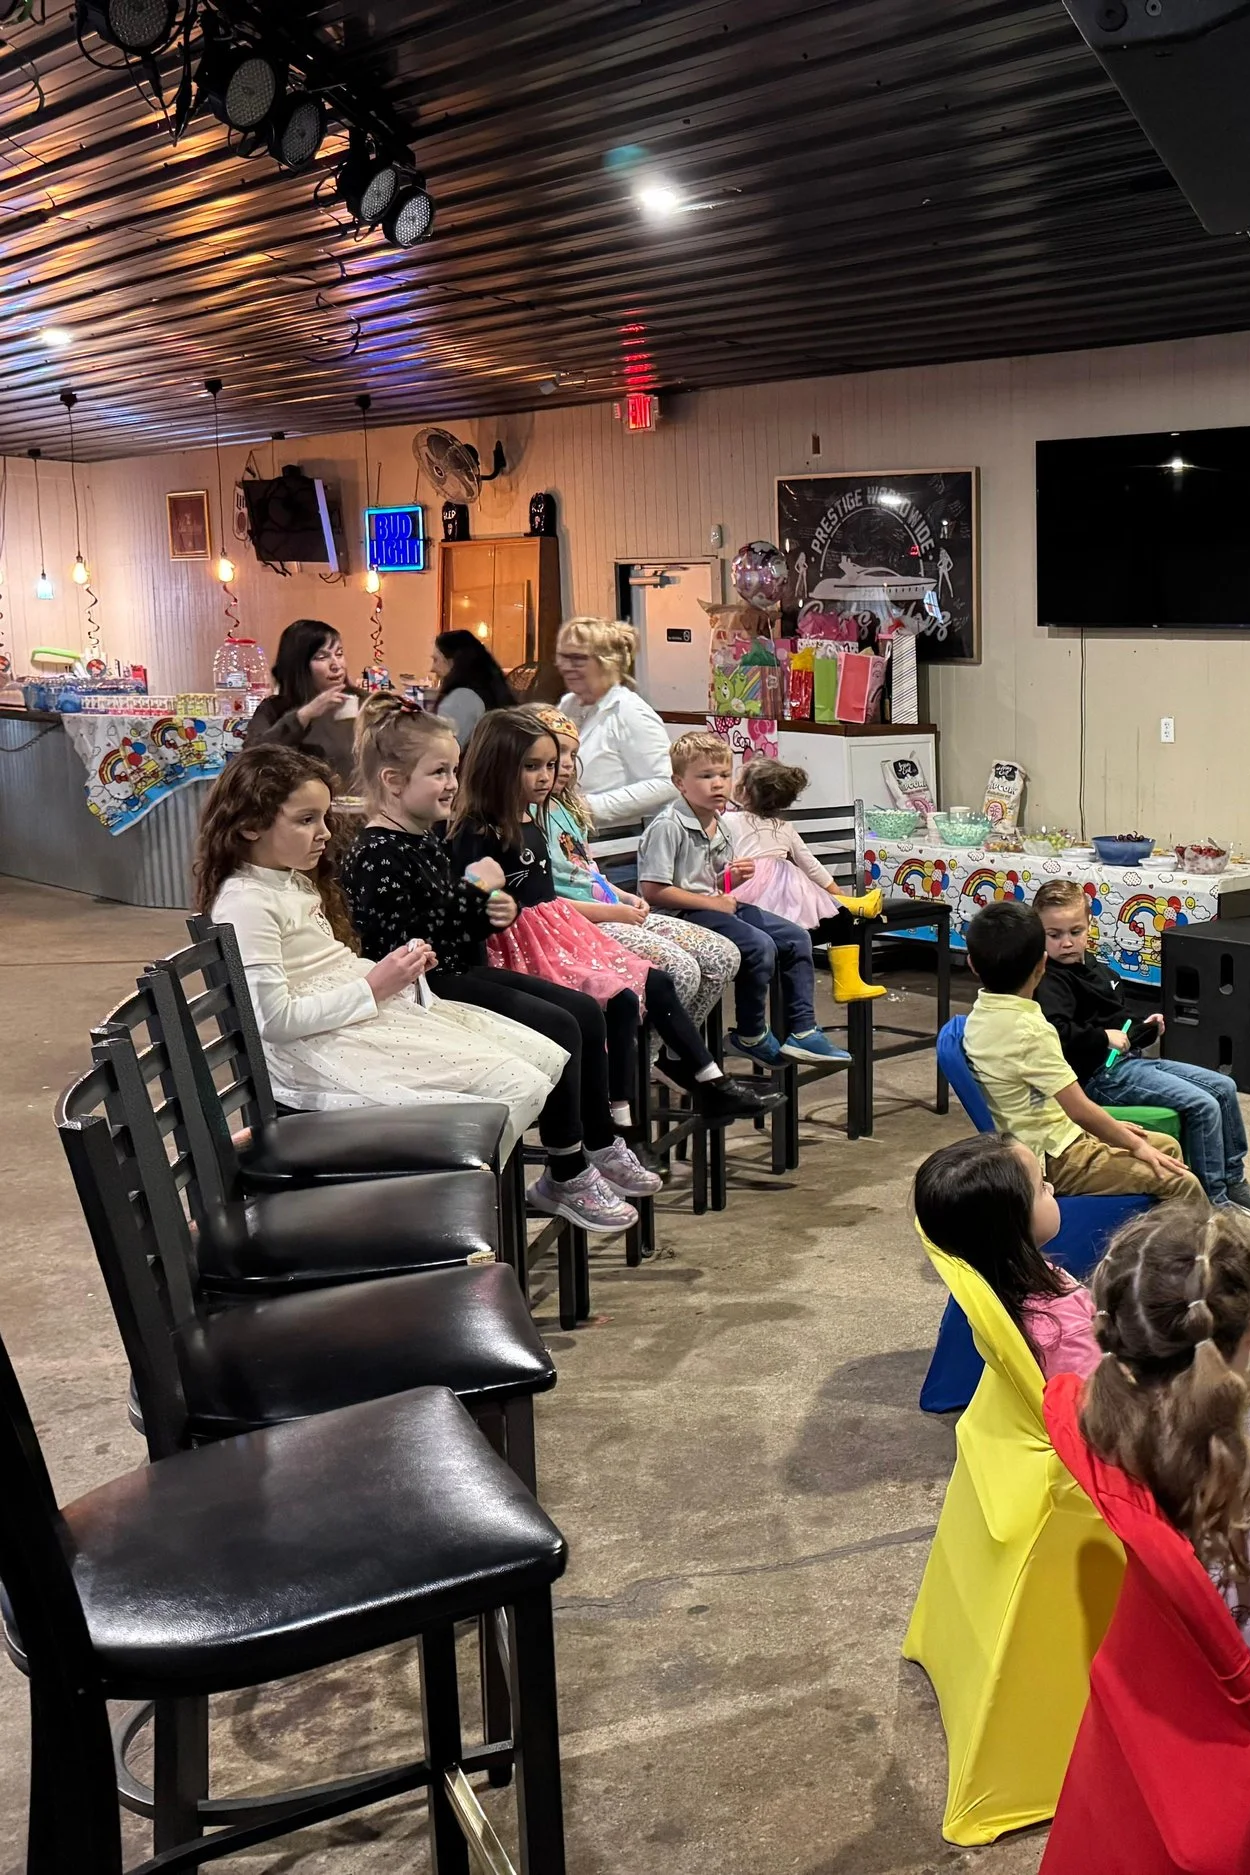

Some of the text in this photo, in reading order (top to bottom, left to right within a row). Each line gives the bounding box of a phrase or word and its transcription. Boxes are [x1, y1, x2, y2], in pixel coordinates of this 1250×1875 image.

[628, 395, 652, 429] EXIT
[376, 514, 412, 540] BUD
[811, 485, 936, 555] PRESTIGE WORDWIDE
[371, 540, 421, 565] LIGHT
